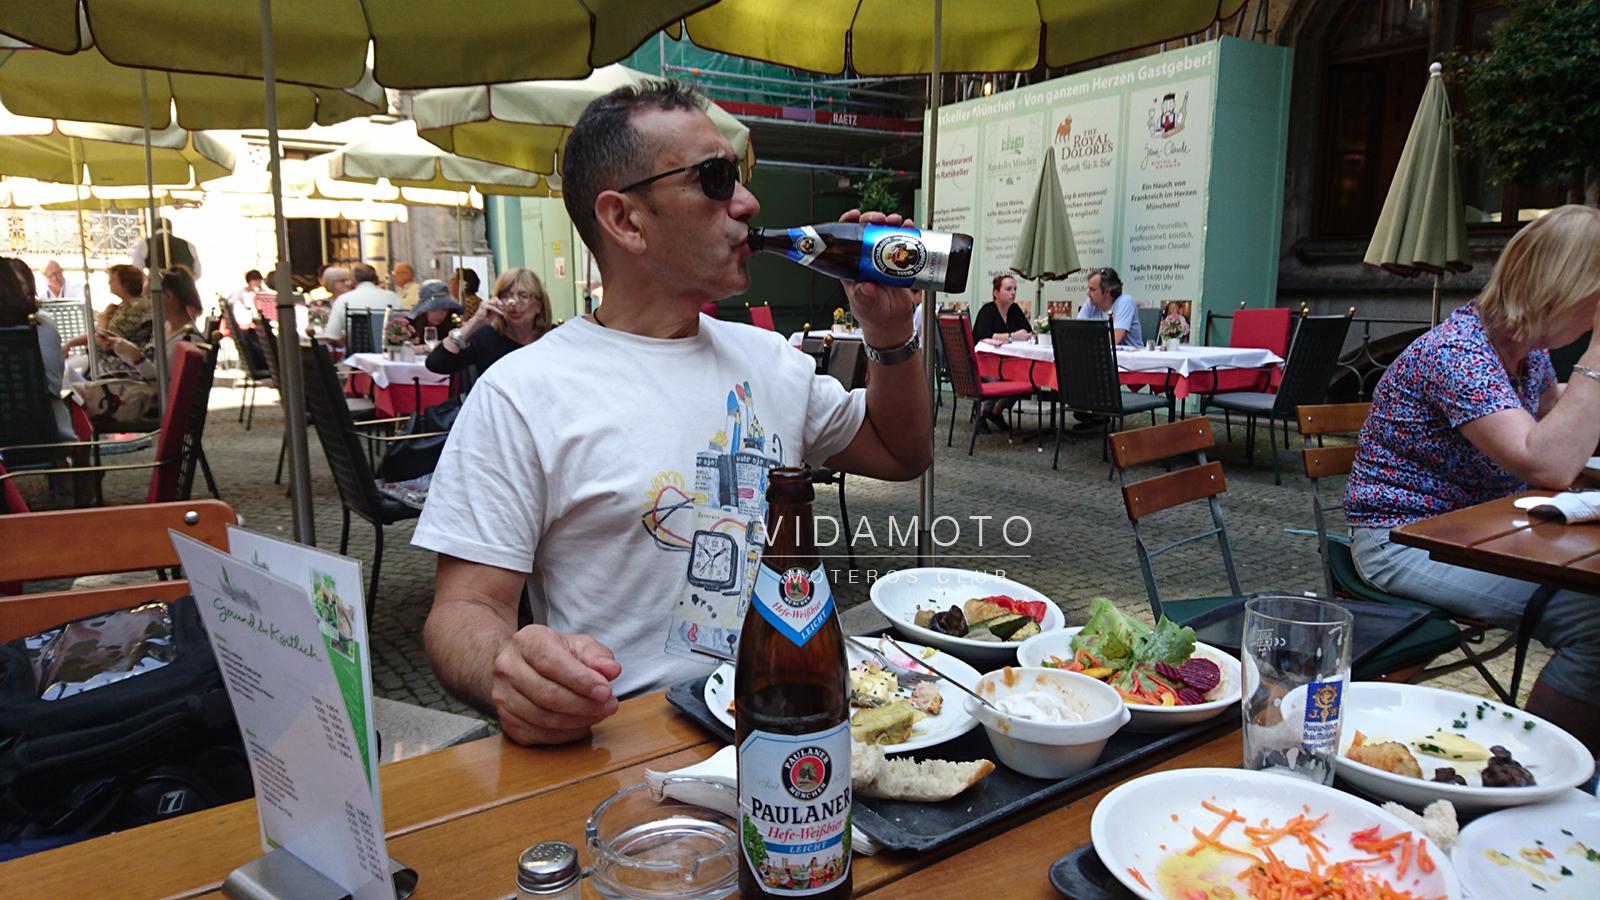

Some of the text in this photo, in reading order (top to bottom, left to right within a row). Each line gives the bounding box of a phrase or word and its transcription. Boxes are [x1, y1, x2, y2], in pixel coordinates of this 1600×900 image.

[972, 101, 1016, 117] München
[1024, 94, 1044, 106] Von
[1046, 82, 1089, 105] ganzem
[1092, 71, 1135, 91] Herzen
[1138, 51, 1212, 80] Gastgeber!
[832, 113, 858, 126] RAETZ
[1084, 128, 1097, 137] THE
[1074, 133, 1110, 148] ROYAL
[1061, 142, 1114, 160] DOLORES
[942, 155, 973, 167] Restaurant
[1153, 180, 1173, 189] Hauch
[1131, 191, 1163, 202] Frankreich
[1174, 190, 1197, 198] Herzen
[1145, 201, 1180, 210] Münchens!
[1130, 264, 1151, 273] Täglich
[1152, 264, 1173, 272] Happy
[772, 601, 822, 621] Hefe-Weißbier
[800, 609, 827, 640] LEICHT
[784, 747, 830, 770] PAULANER
[751, 786, 851, 825] PAULANER
[767, 818, 844, 843] Hefe-Weißbier
[788, 841, 828, 854] LEICHT
